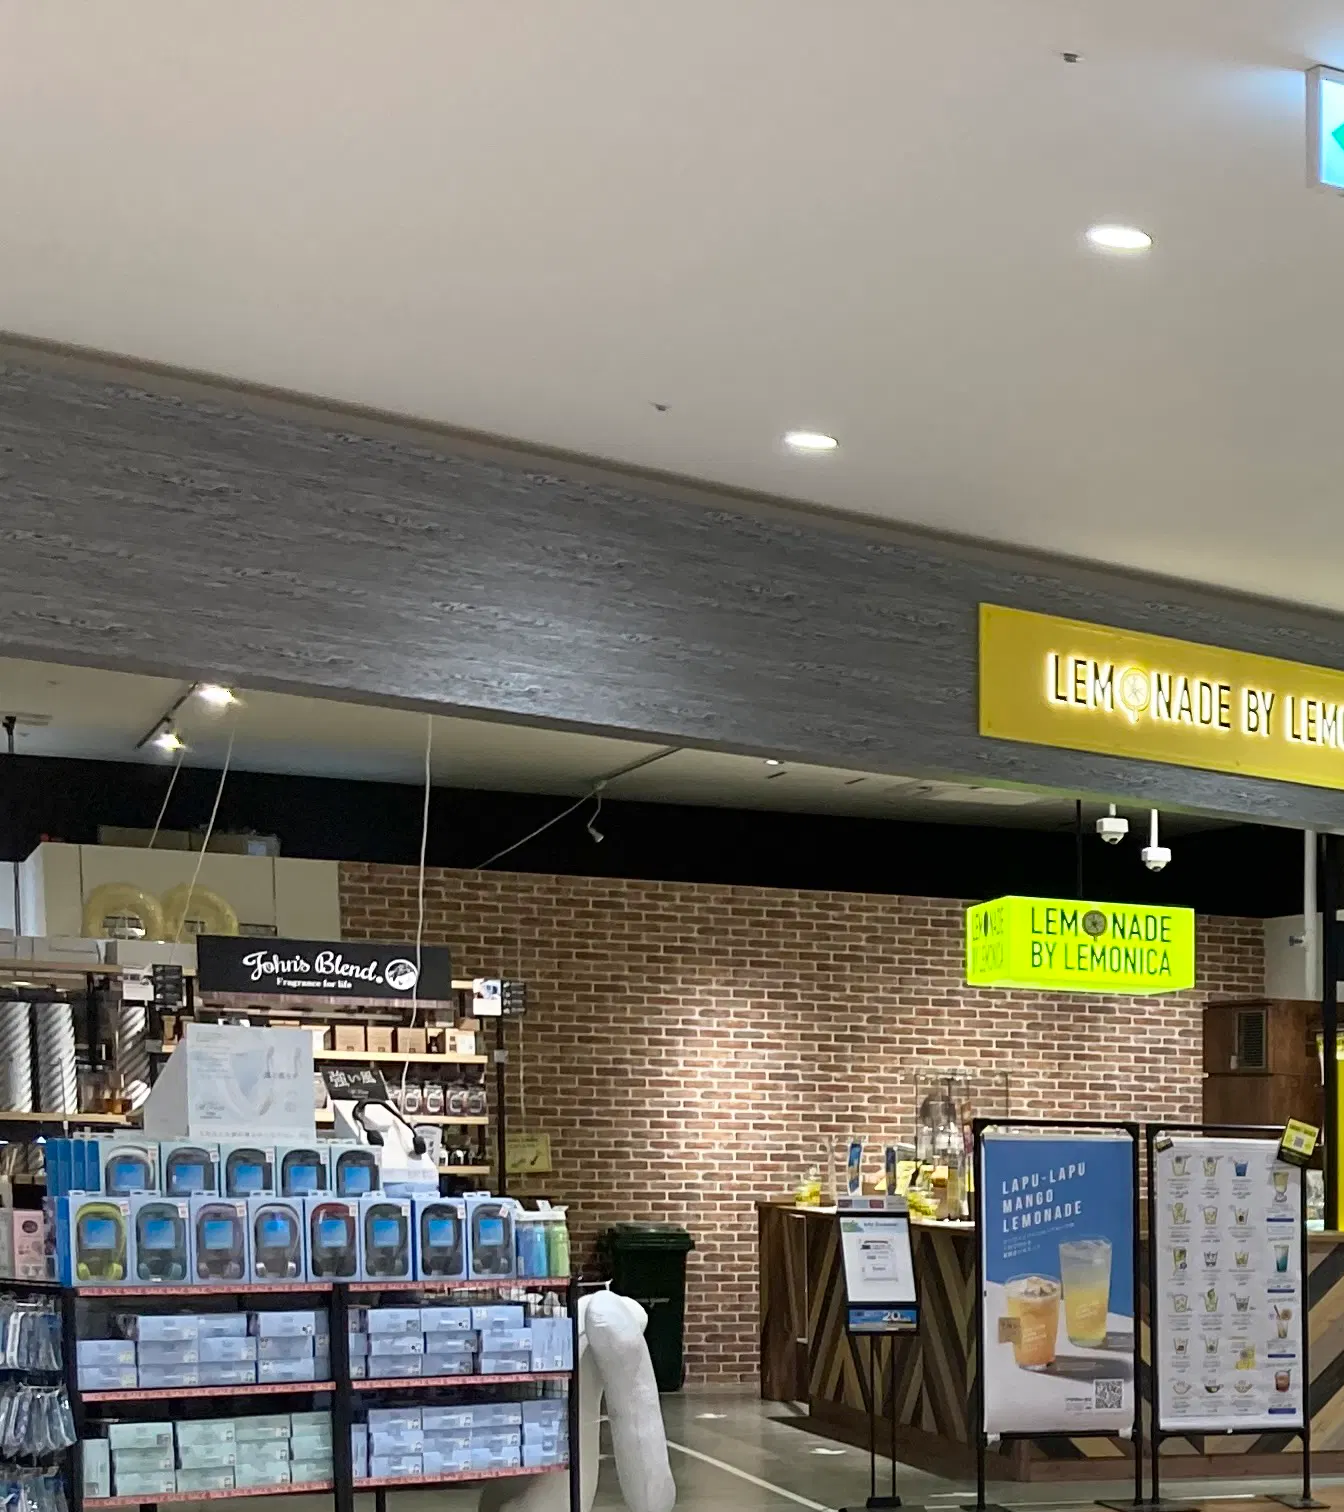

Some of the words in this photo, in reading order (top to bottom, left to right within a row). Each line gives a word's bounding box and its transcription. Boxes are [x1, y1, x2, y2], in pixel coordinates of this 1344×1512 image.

[1049, 652, 1231, 729] LEMONADE
[1245, 687, 1276, 737] BY
[1031, 906, 1172, 943] LEMONADE
[242, 950, 311, 982] John's
[1031, 940, 1057, 969] BY
[1064, 944, 1172, 977] LEMONICA
[276, 976, 322, 989] Fragrance
[323, 979, 336, 989] for
[337, 980, 353, 989] life
[328, 1069, 377, 1090] 強い風
[1002, 1161, 1086, 1195] LAPU-LAPU
[1002, 1188, 1054, 1214] MANGO
[1003, 1200, 1082, 1233] LEMONADE
